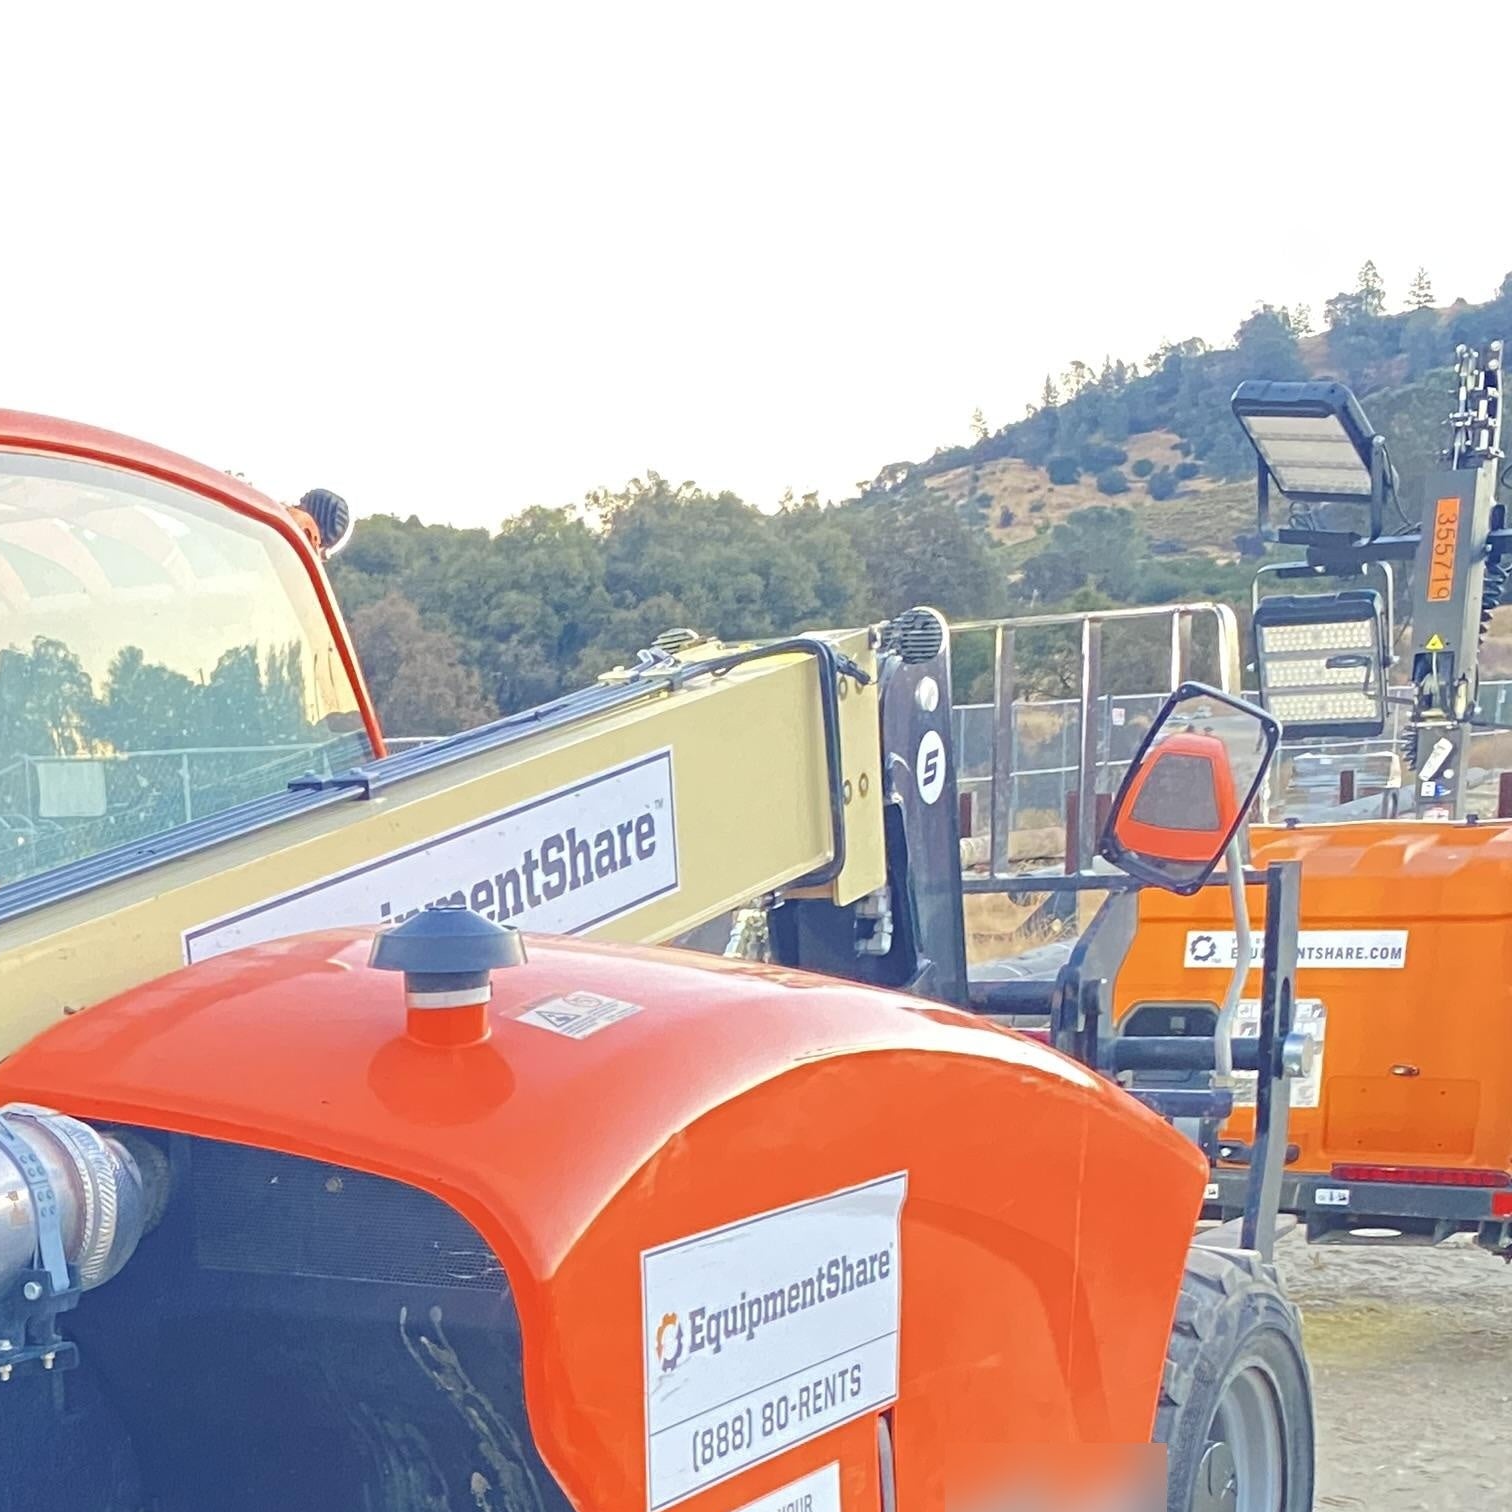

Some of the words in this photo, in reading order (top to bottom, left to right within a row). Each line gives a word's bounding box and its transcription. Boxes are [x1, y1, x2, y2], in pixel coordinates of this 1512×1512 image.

[1432, 513, 1458, 599] 355719
[380, 811, 656, 925] entShare
[688, 1248, 890, 1355] EquipmentShare
[692, 1408, 752, 1473] (888)
[761, 1364, 862, 1437] 80-RENTS
